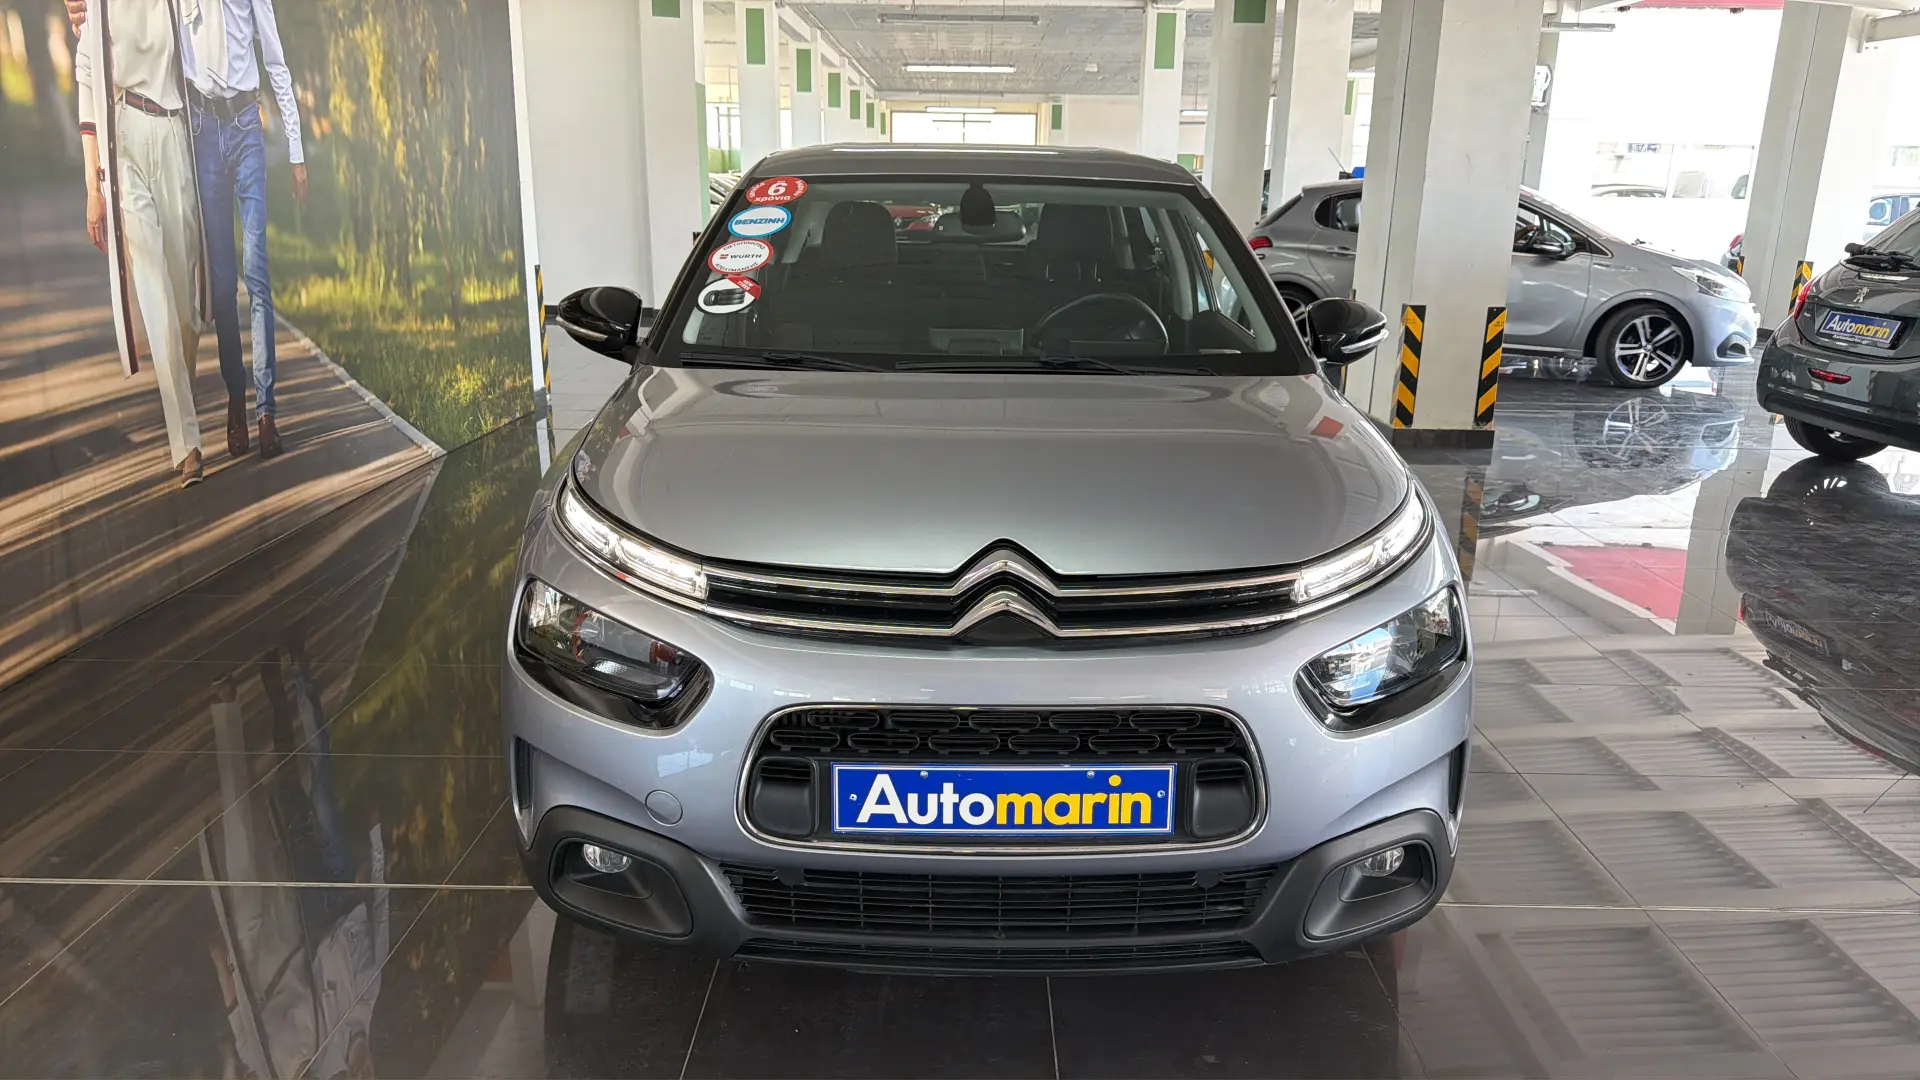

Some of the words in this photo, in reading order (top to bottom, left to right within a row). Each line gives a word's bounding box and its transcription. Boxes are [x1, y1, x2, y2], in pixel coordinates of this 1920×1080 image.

[768, 182, 788, 196] 6
[754, 195, 791, 203] χρόνια
[1826, 314, 1890, 339] Automarin
[856, 773, 1151, 825] Automarin
